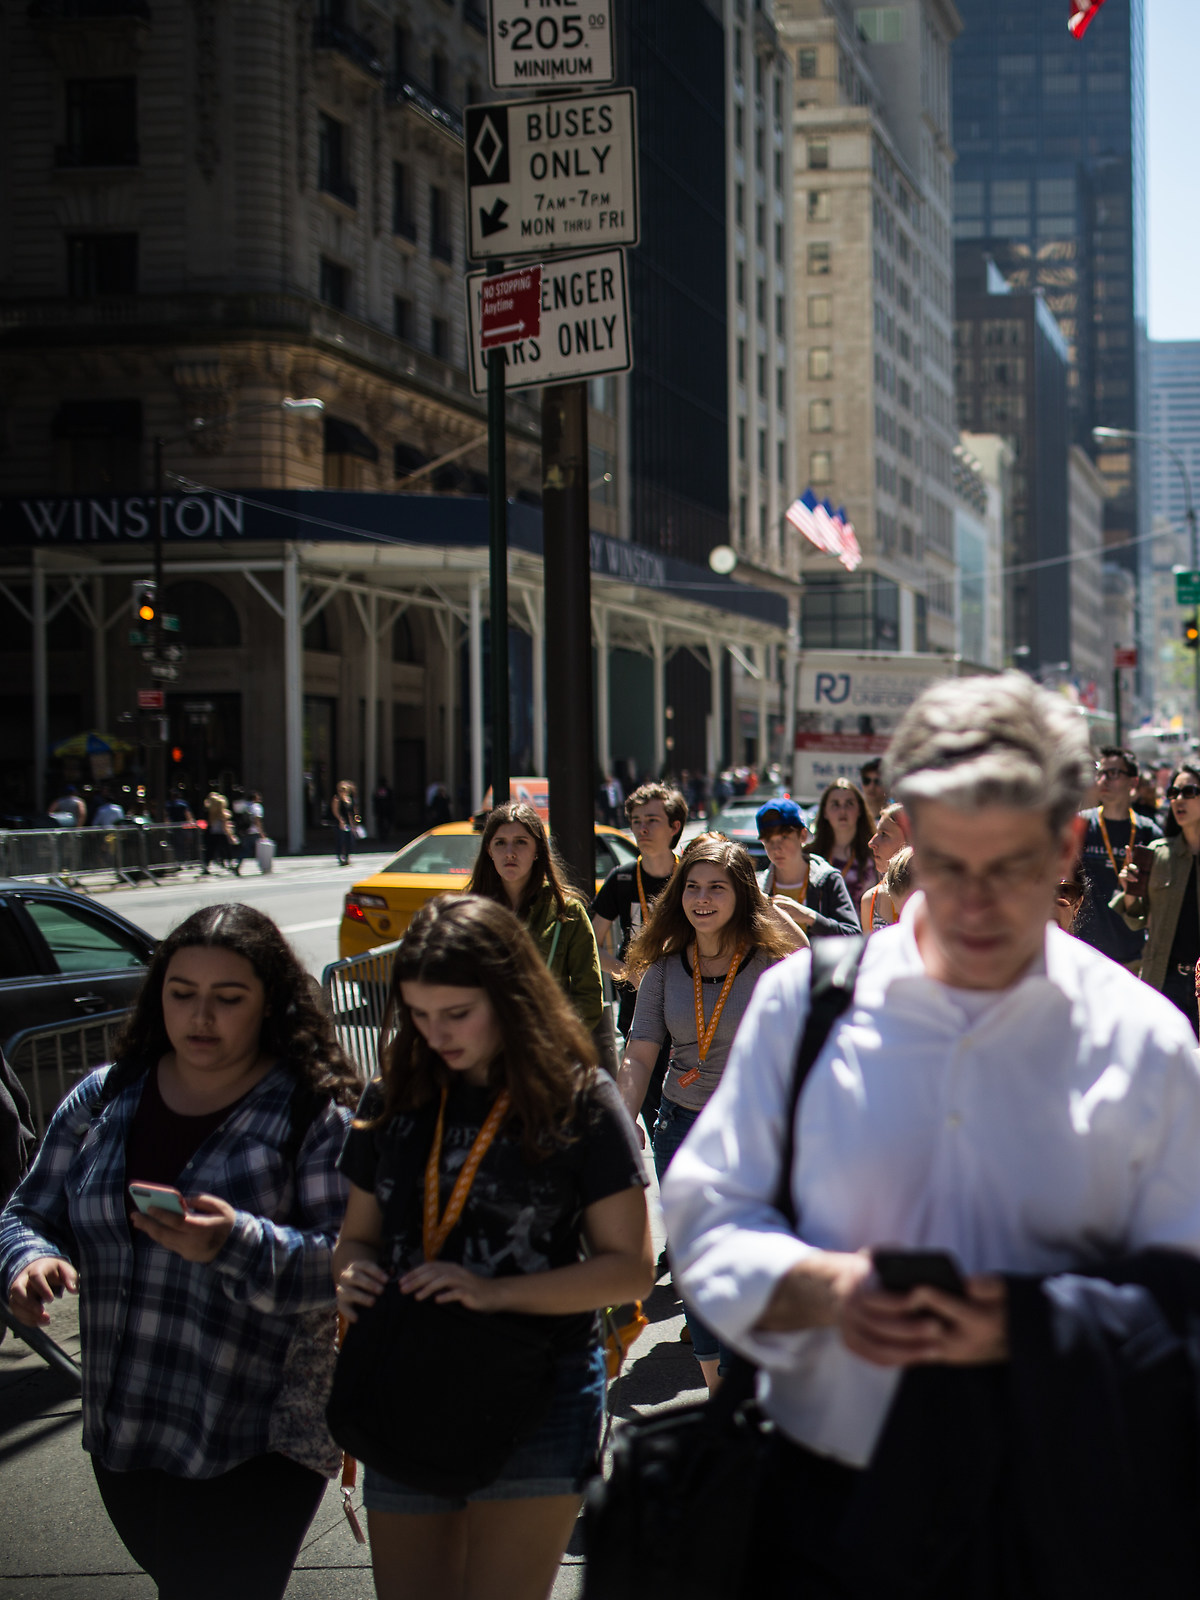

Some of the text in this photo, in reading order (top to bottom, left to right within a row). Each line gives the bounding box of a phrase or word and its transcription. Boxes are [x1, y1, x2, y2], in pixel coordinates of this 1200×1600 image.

[514, 57, 592, 78] MINIMUM
[527, 105, 612, 142] BUSES
[530, 144, 611, 180] ONLY
[521, 210, 625, 236] MON THRU FRI
[483, 276, 531, 300] NO STOPPING
[541, 267, 615, 312] ENGER
[483, 299, 514, 317] Anytime
[558, 314, 617, 357] ONLY
[20, 496, 245, 540] WINSTON
[815, 672, 851, 704] RJ
